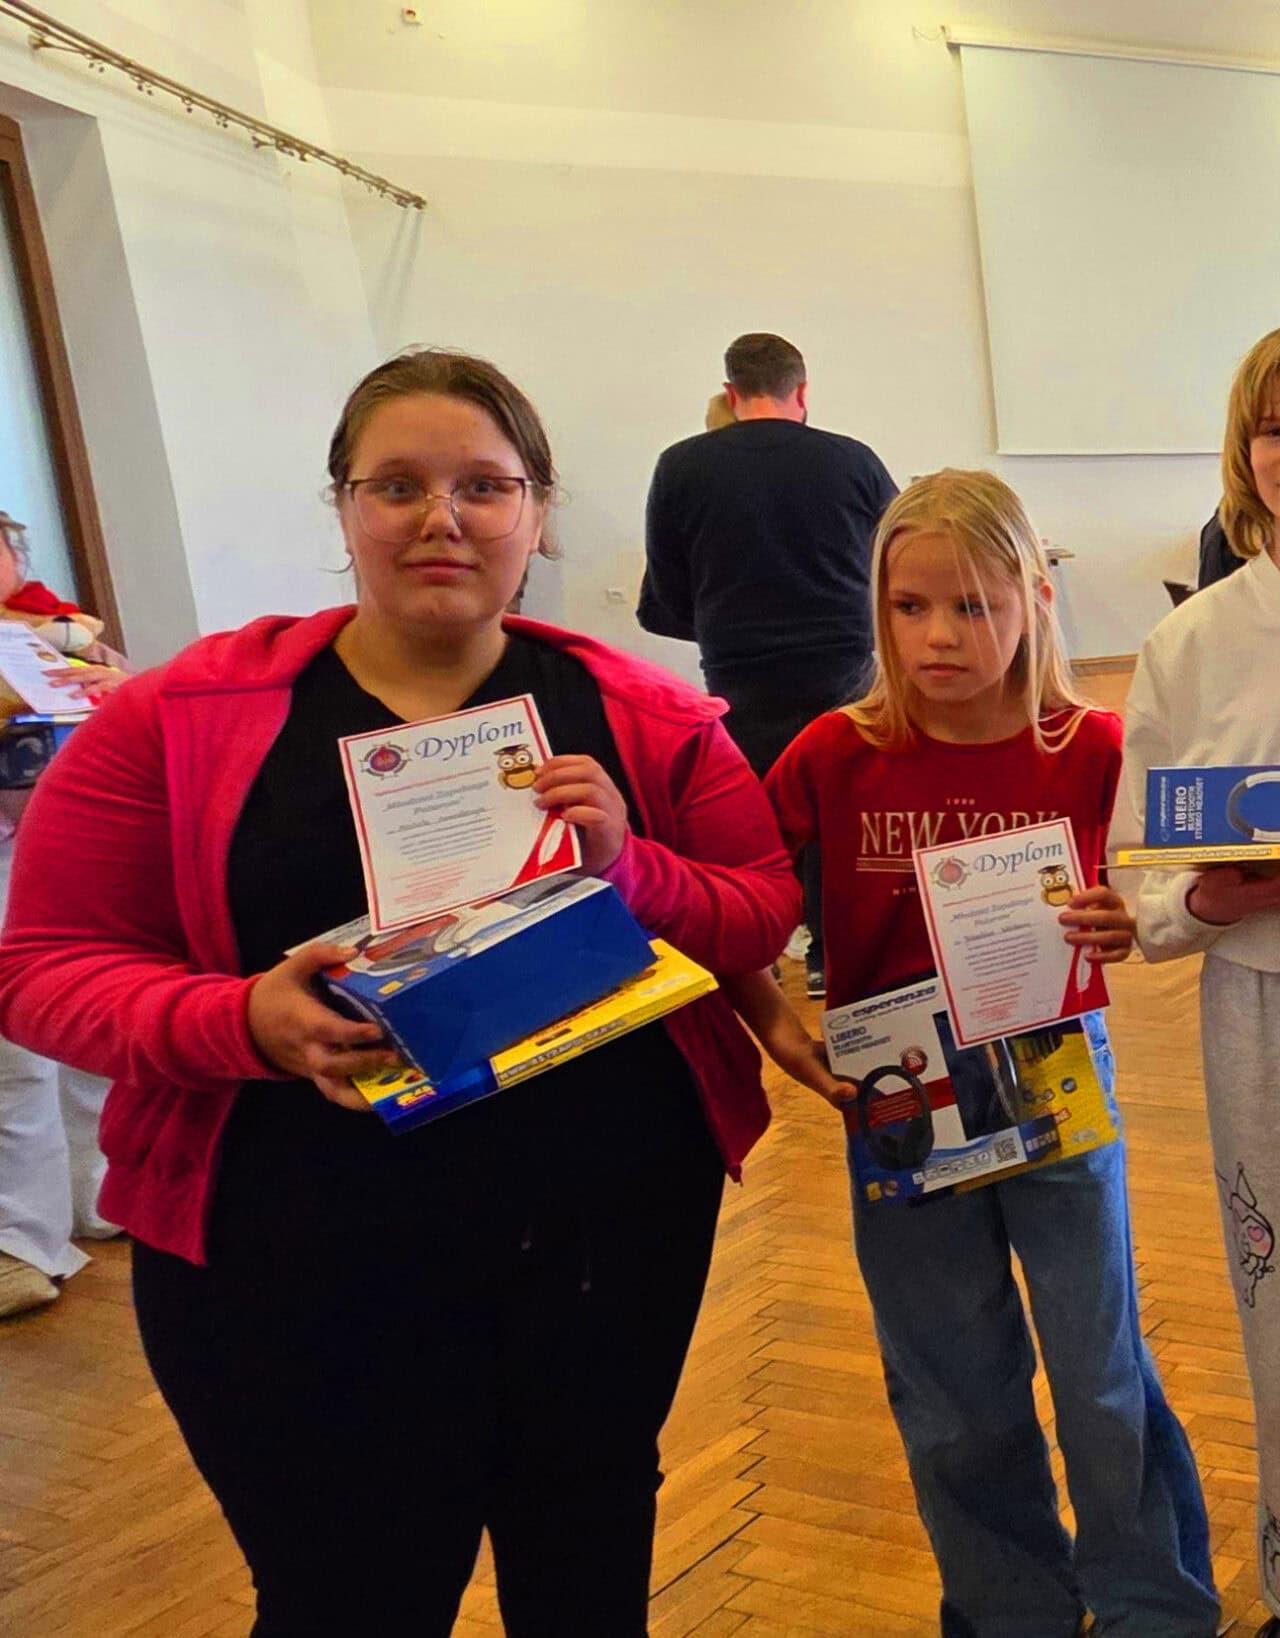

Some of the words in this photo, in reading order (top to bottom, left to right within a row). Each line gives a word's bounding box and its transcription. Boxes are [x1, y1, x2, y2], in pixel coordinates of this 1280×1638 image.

[415, 720, 524, 761] Dyplom
[1175, 786, 1188, 832] LIBERO
[860, 811, 947, 855] NEW
[974, 841, 1064, 876] Dyplom
